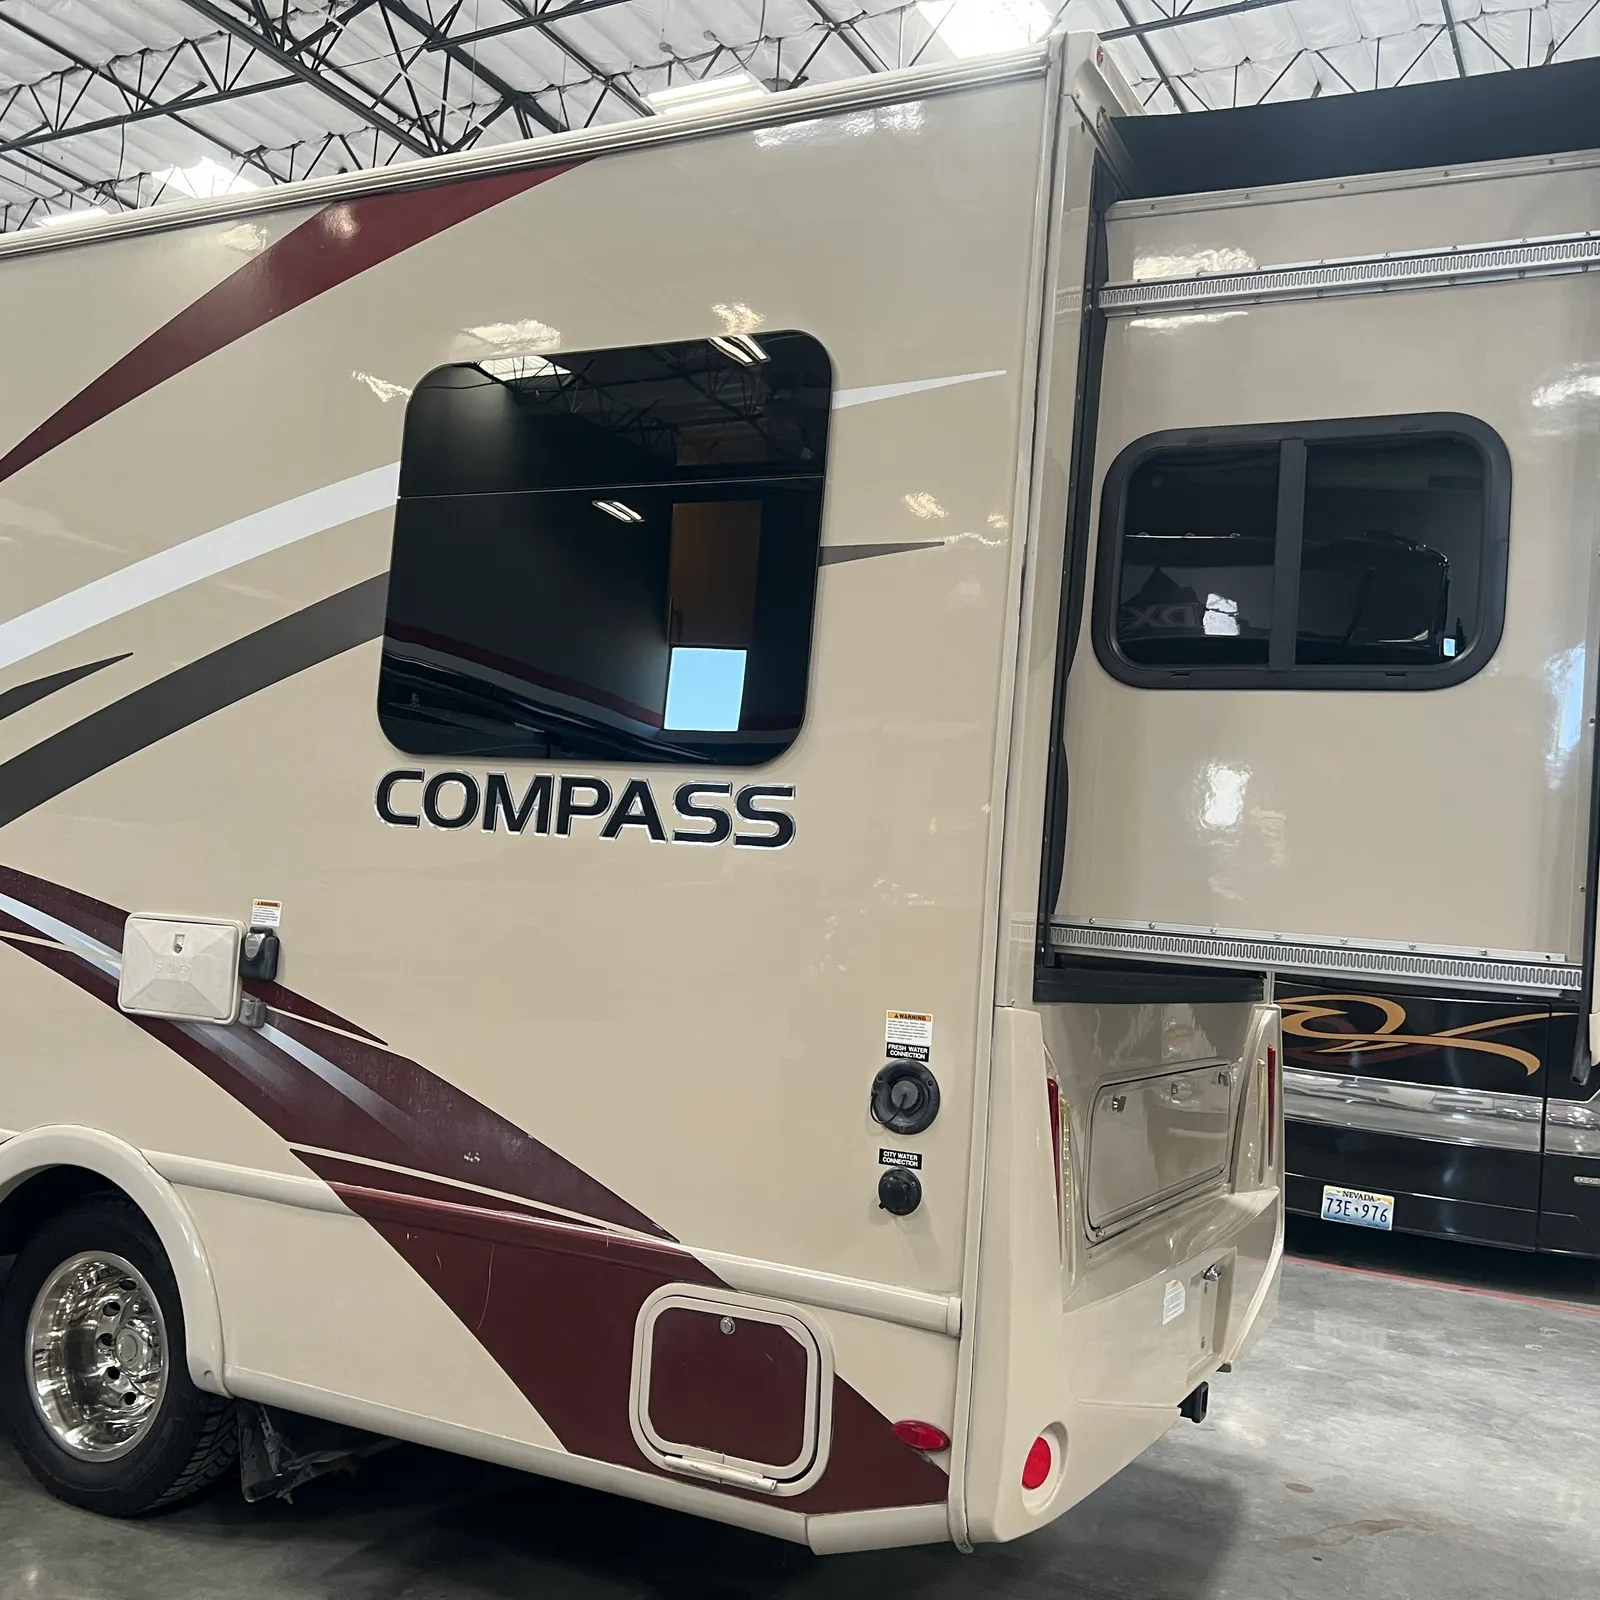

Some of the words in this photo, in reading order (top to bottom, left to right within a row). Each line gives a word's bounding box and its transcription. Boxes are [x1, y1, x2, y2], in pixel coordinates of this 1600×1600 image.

[373, 767, 797, 850] COMPASS
[899, 1013, 927, 1021] WARNING
[887, 1043, 907, 1051] FRESH
[908, 1046, 928, 1054] WATER
[890, 1049, 926, 1059] CONNECTION
[883, 1150, 896, 1158] CITY
[897, 1152, 918, 1161] WATER
[882, 1157, 918, 1167] CONNECTION
[1342, 1191, 1375, 1202] NEVADA
